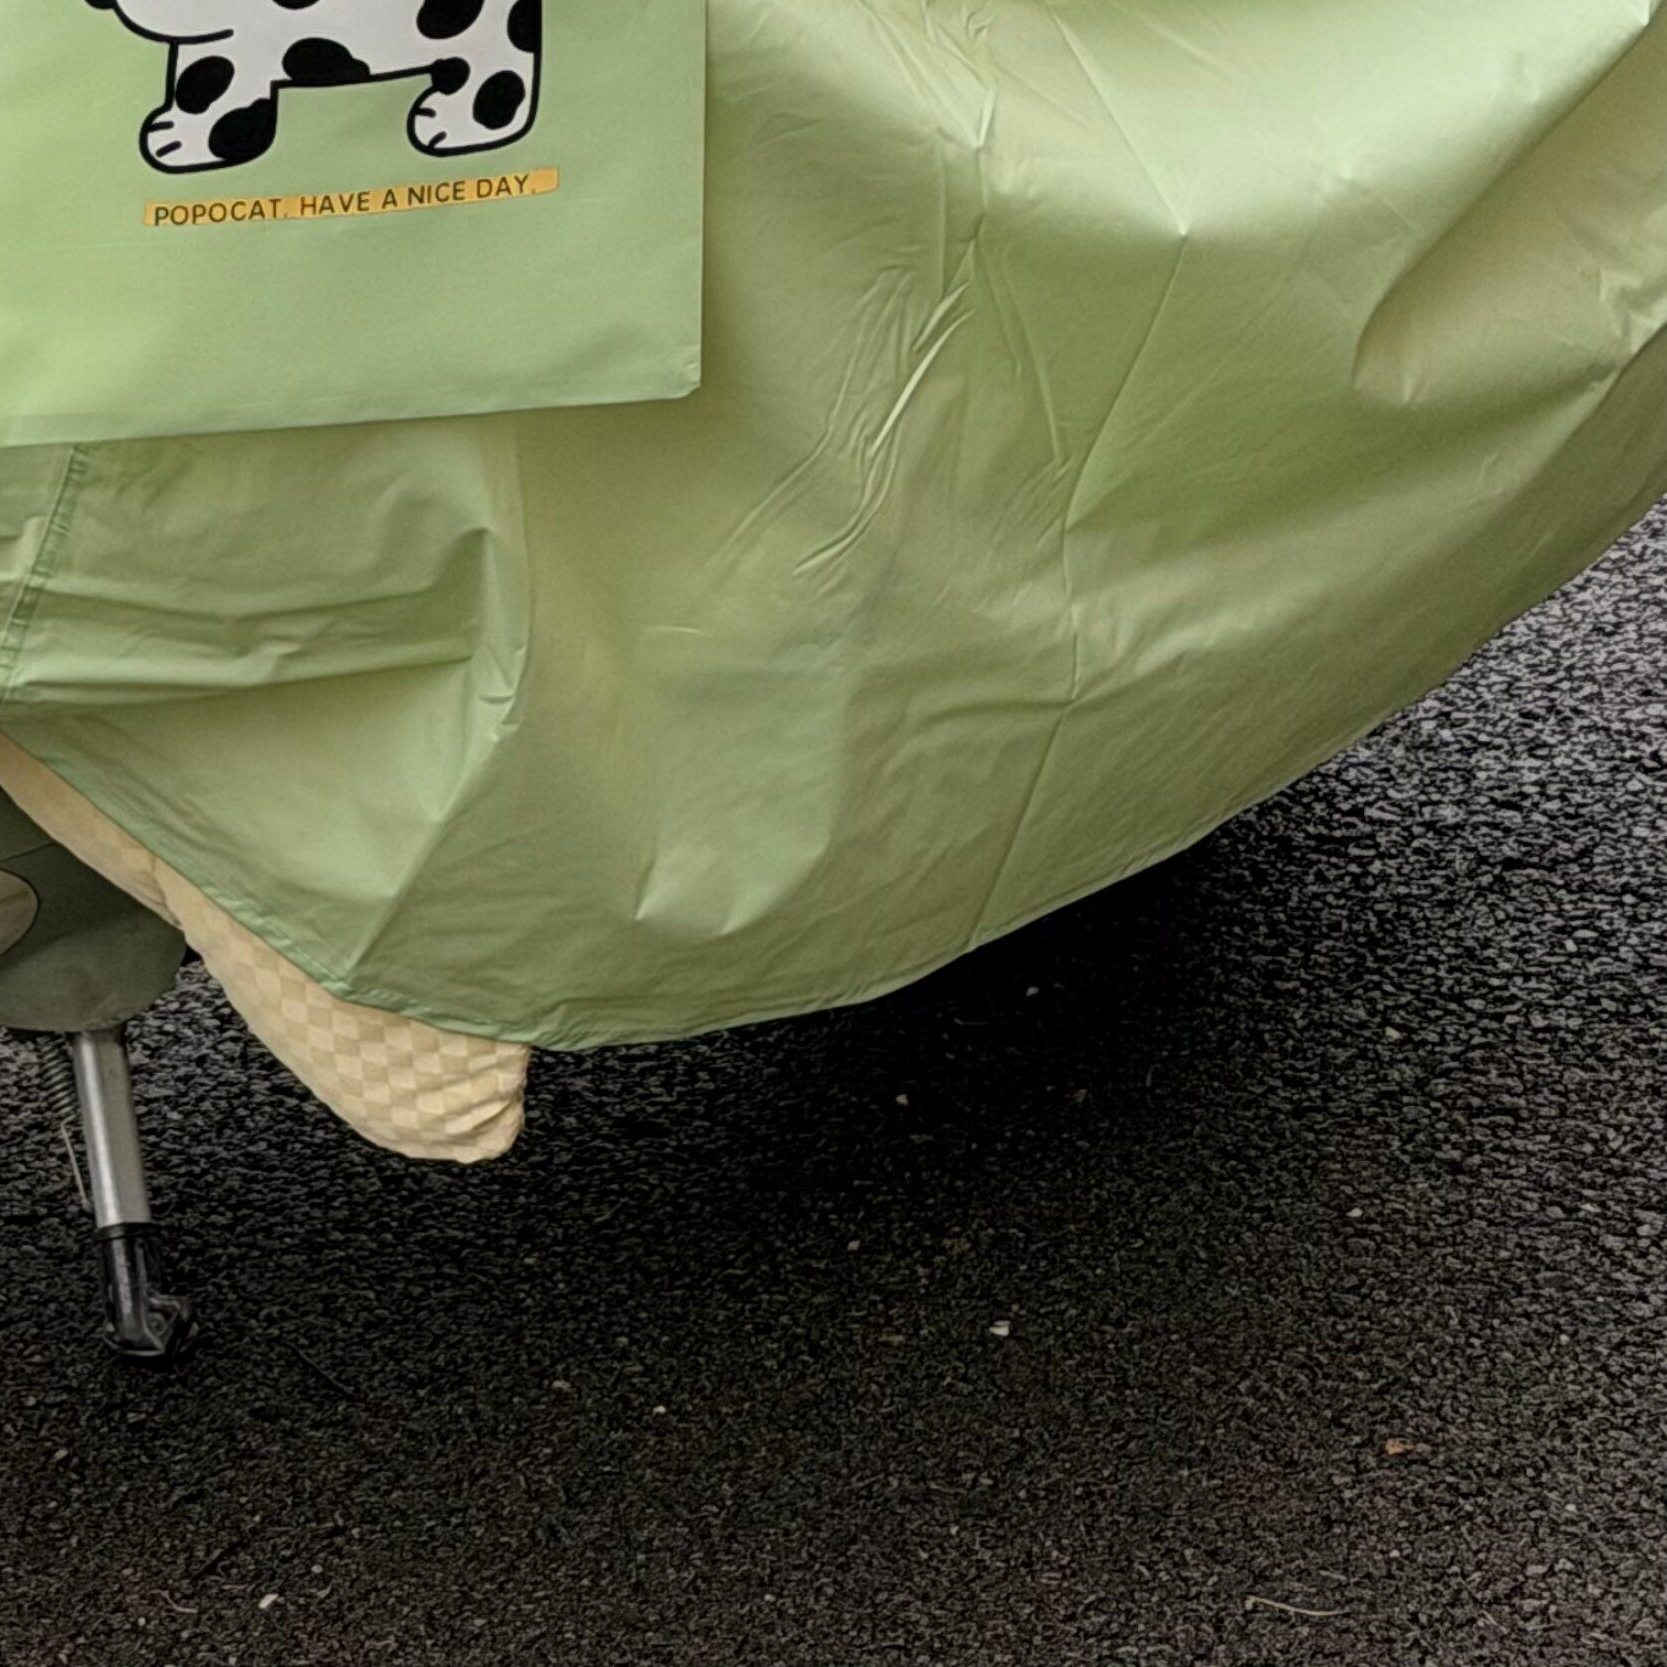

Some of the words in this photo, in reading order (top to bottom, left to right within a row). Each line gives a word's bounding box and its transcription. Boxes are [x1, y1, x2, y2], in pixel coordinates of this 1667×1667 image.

[300, 191, 372, 217] HAVE
[381, 188, 399, 210] A
[407, 180, 466, 205] NICE
